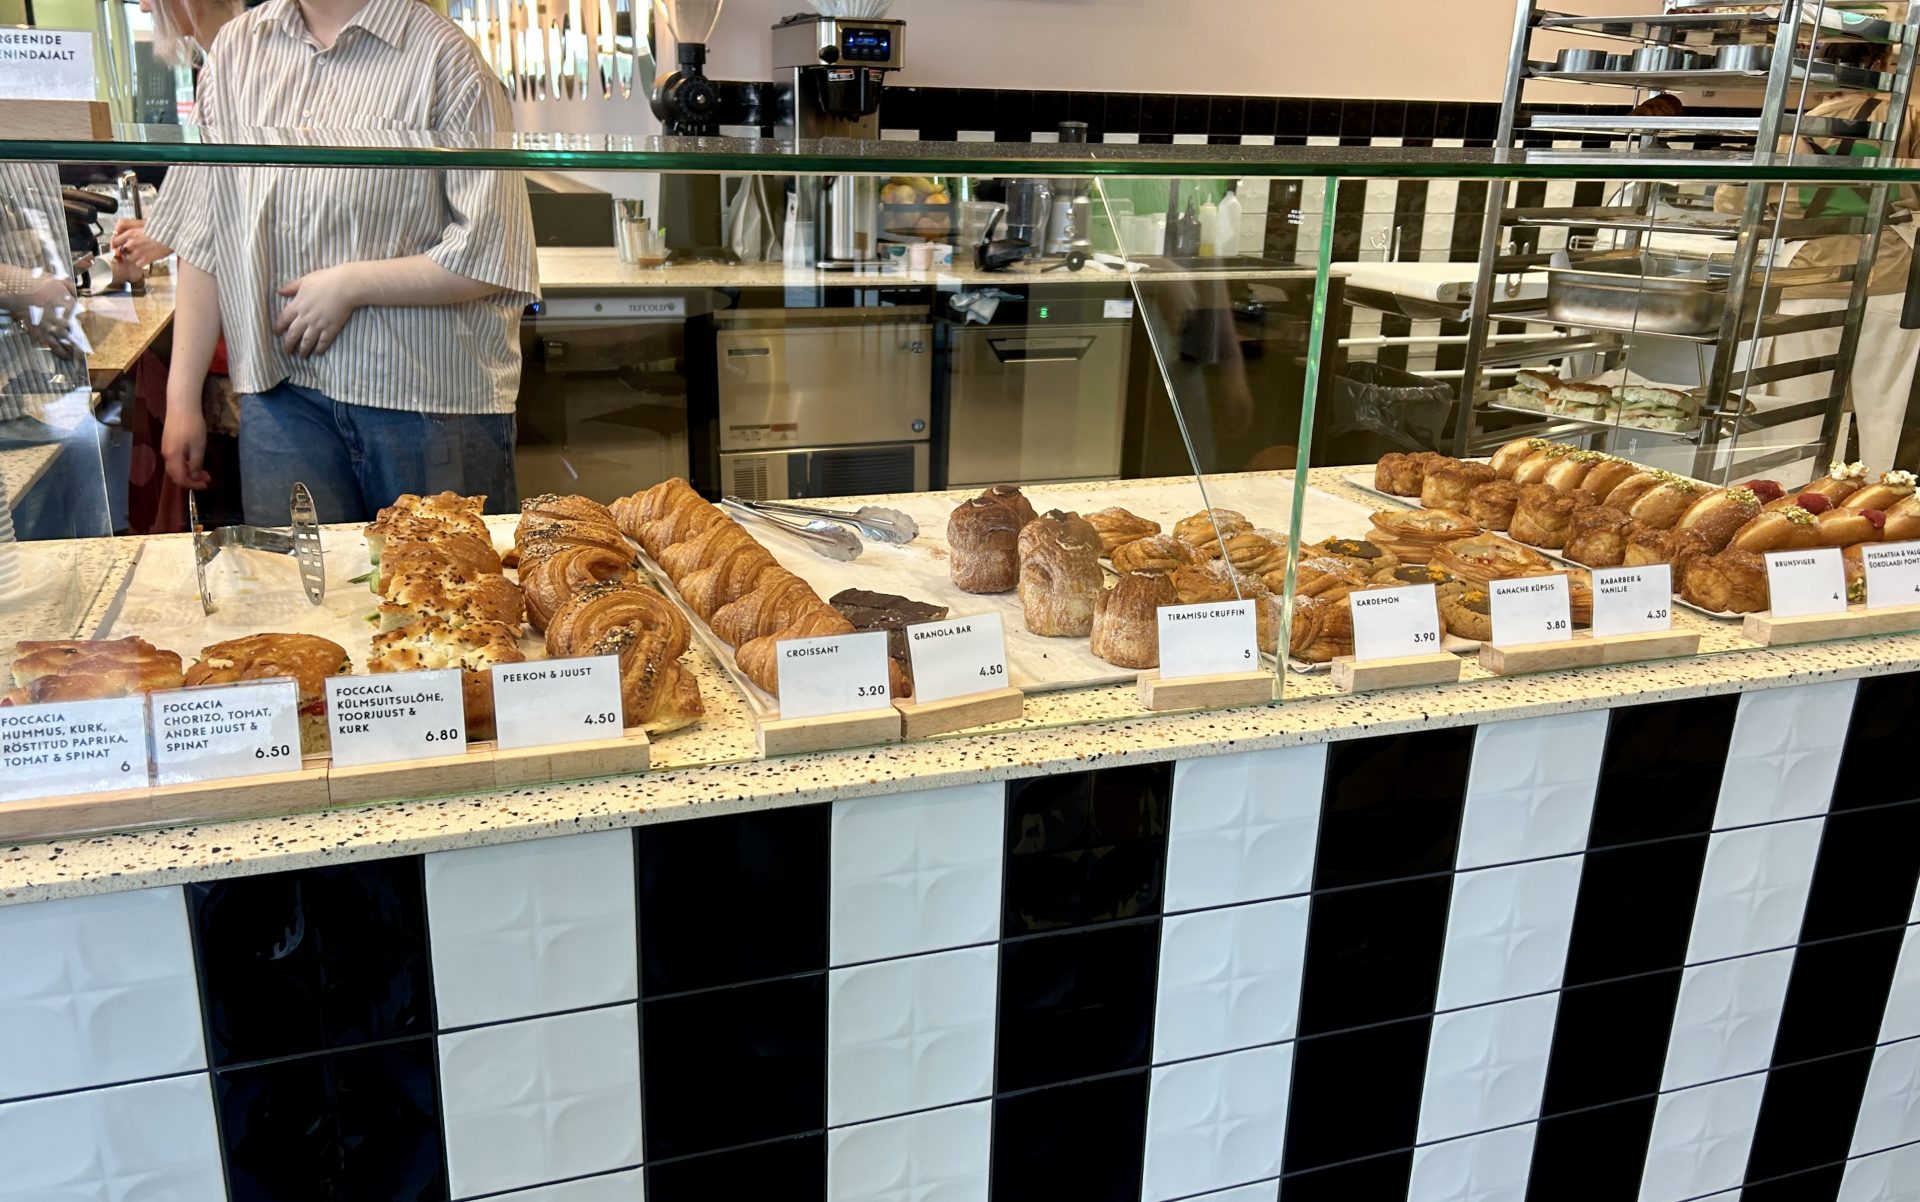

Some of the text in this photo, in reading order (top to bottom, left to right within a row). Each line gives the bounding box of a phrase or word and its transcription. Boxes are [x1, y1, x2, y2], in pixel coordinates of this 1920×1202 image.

[0, 49, 75, 61] NINDAJALT
[1867, 551, 1901, 560] PISTAATSIA
[1901, 549, 1906, 557] &
[1774, 558, 1816, 568] BRUNSVIGER
[1600, 575, 1635, 586] RABARBER
[1496, 583, 1555, 596] GANACHE KÜPSIS
[1600, 585, 1628, 595] VANILJE
[1832, 591, 1839, 600] 4
[1356, 596, 1400, 607] KARDEMON
[1167, 608, 1245, 621] TIRAMISU CRUFFIN
[1646, 609, 1667, 620] 4.30
[1546, 619, 1567, 631] 3.80
[913, 624, 972, 641] GRANOLA BAR
[1413, 631, 1436, 643] 3.90
[786, 645, 839, 658] CROISSANT
[1243, 648, 1251, 659] 5
[502, 667, 592, 683] PEEKON & JUUST
[978, 663, 1003, 677] 4.50
[336, 684, 393, 697] FOCCACIA
[857, 684, 885, 697] 3.20
[163, 699, 224, 714] FOCCACIA
[337, 692, 444, 710] KÜLMSUITSULÕHE,
[1, 713, 65, 727] FOCCACIA
[163, 707, 272, 727] CHORIZO, TOMAT,
[337, 707, 417, 723] TOORJUUST &
[583, 712, 616, 725] 4.50
[2, 722, 107, 741] HUMMUS, KURK,
[165, 721, 258, 740] ANDRE JUUST &
[338, 723, 370, 735] KURK
[424, 728, 459, 742] 6.80
[3, 734, 129, 754] RÖSTITUD PAPRIKA,
[166, 739, 209, 753] SPINAT
[3, 748, 111, 767] TOMAT & SPINAT
[254, 745, 291, 759] 6.50
[120, 760, 131, 773] 6
